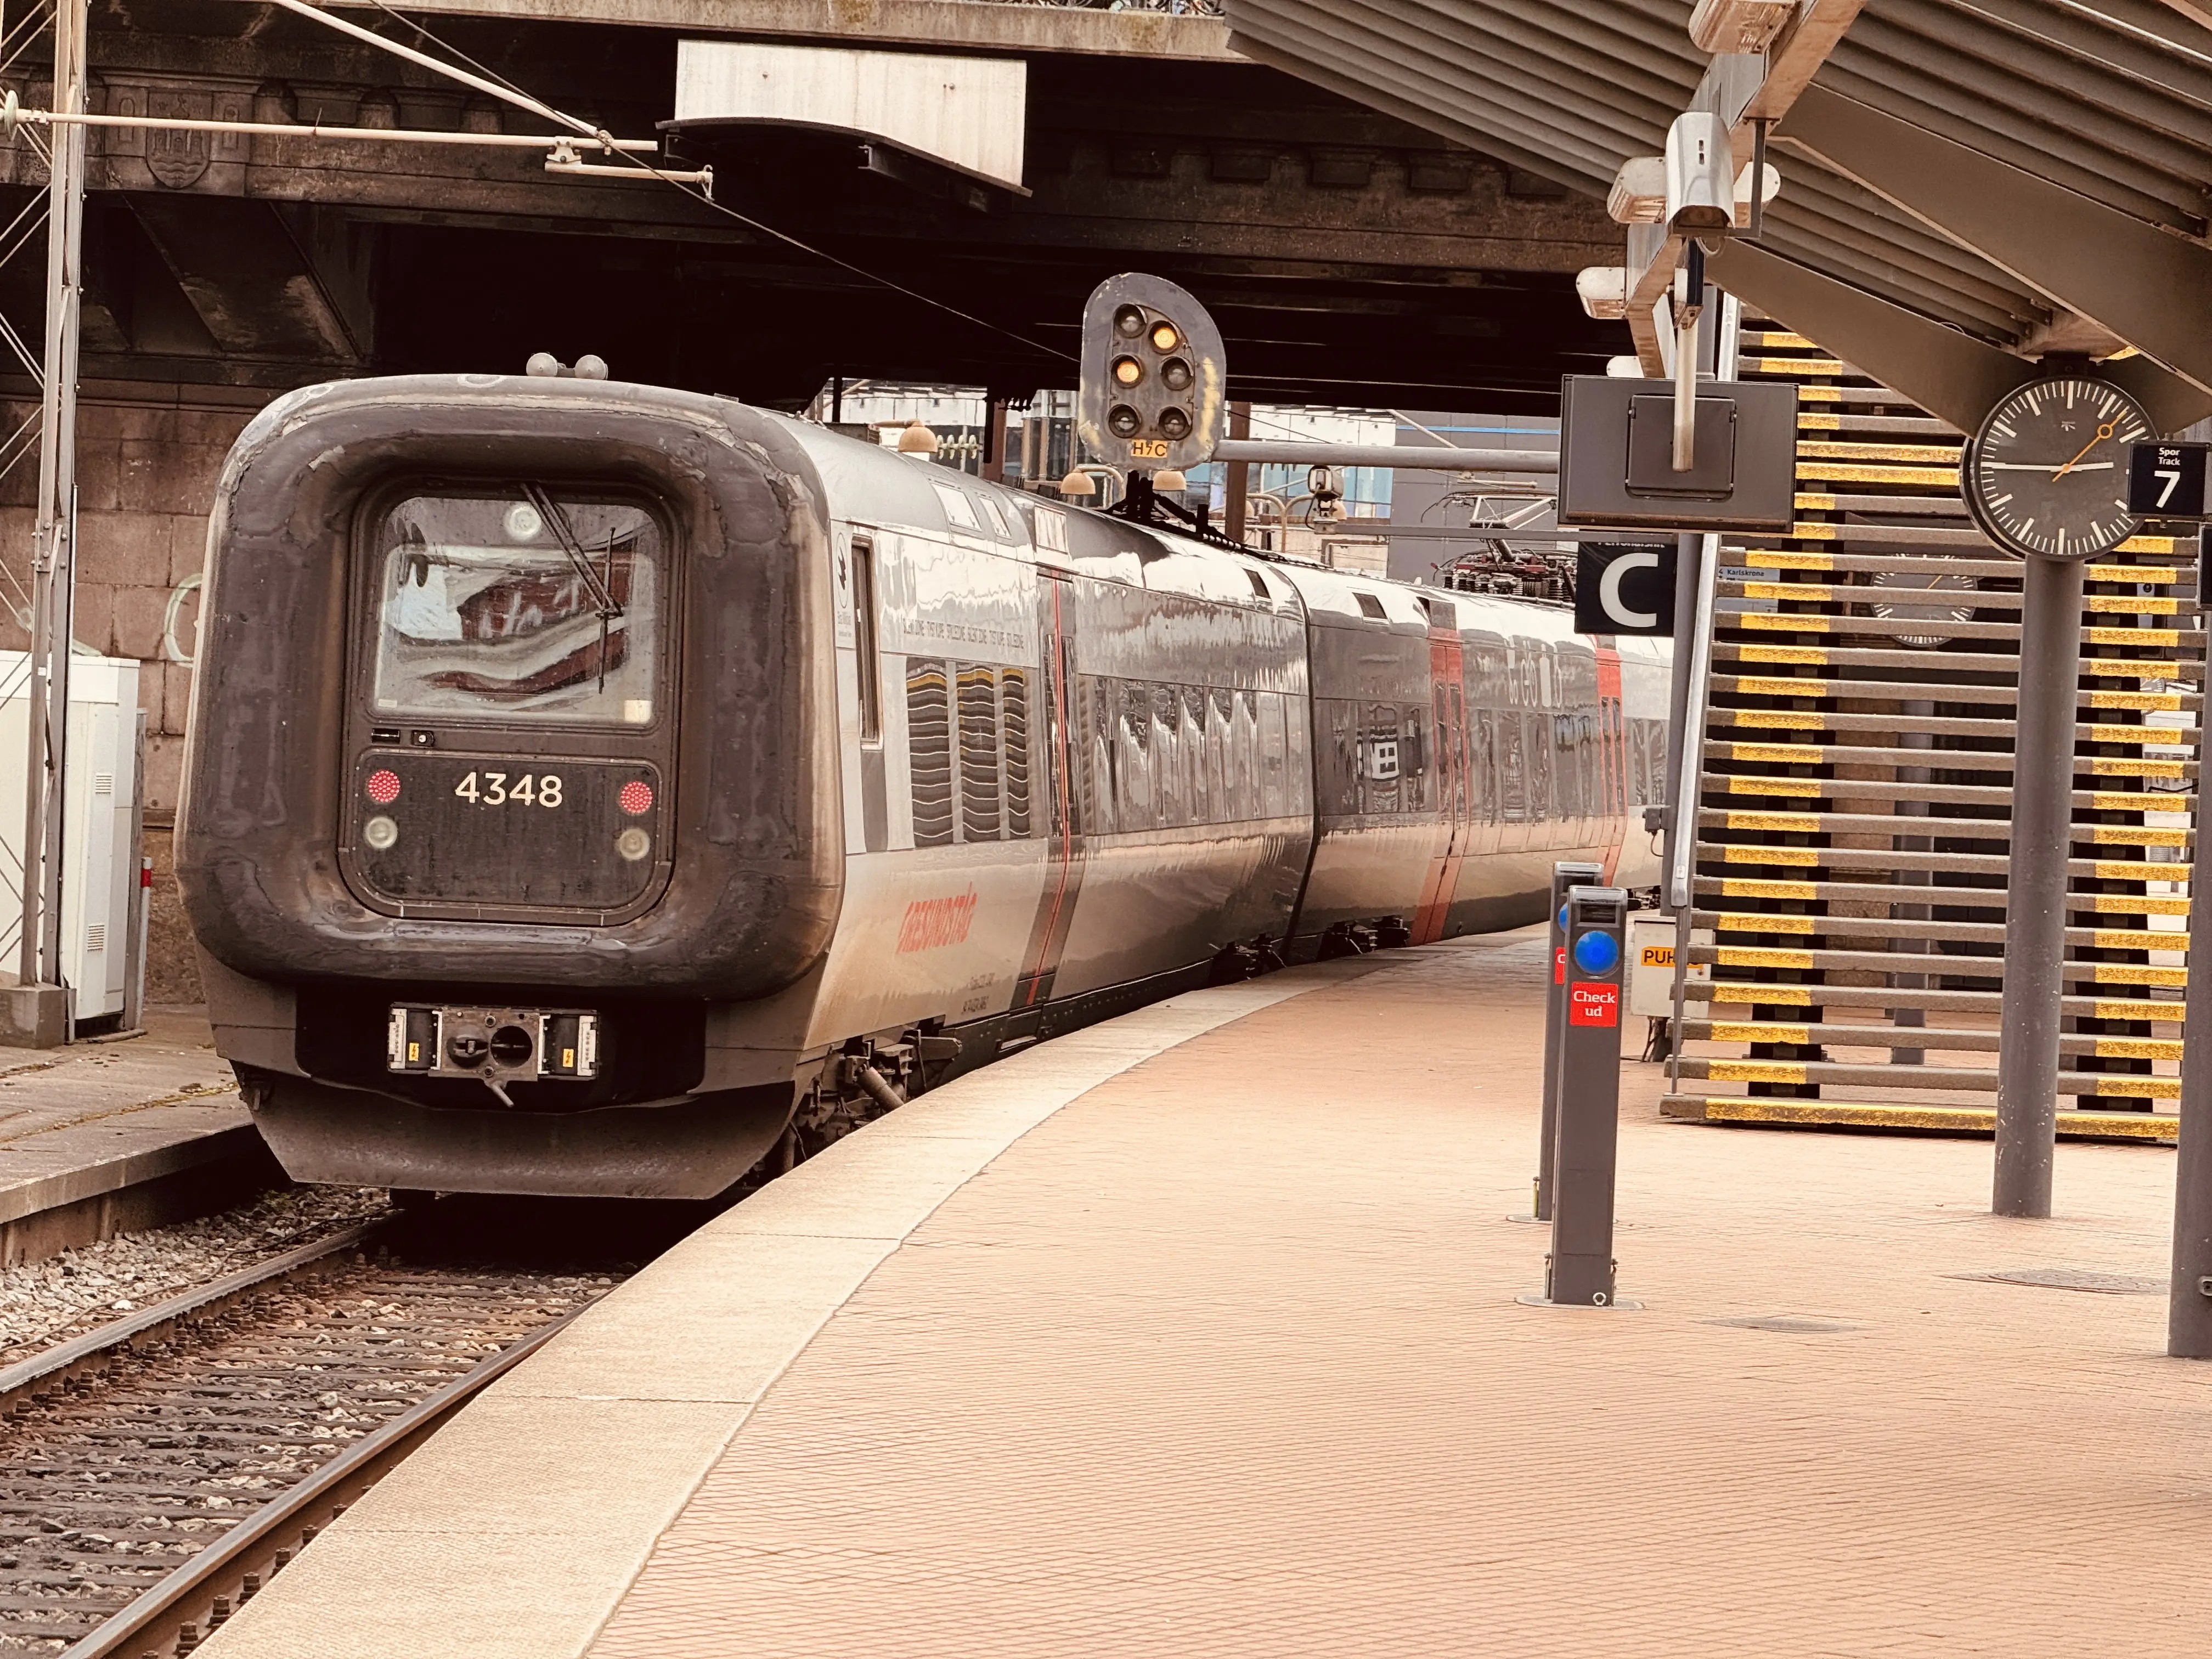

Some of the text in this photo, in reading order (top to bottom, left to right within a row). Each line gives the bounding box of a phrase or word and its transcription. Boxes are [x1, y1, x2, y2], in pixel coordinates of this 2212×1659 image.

[2158, 456, 2181, 466] Track
[2159, 447, 2181, 456] Spor
[2154, 470, 2181, 509] 7
[1600, 552, 1658, 628] C
[455, 772, 563, 808] 4348
[1573, 990, 1616, 1009] Check
[1584, 1005, 1602, 1017] ud
